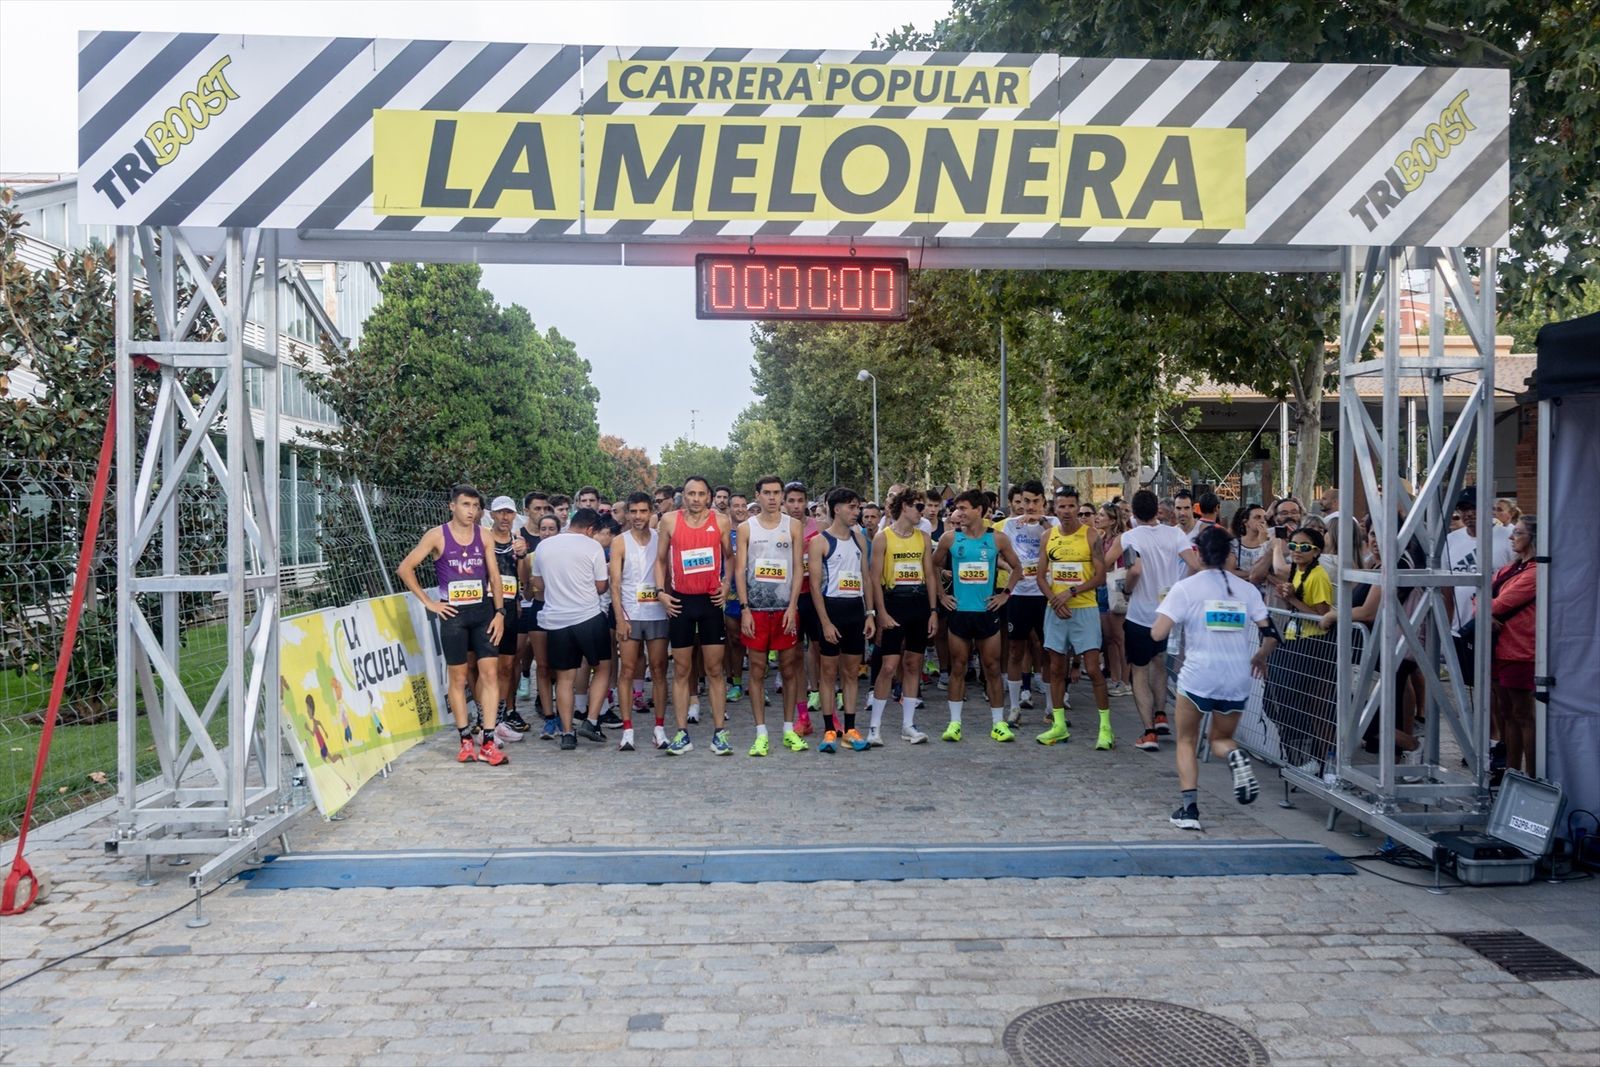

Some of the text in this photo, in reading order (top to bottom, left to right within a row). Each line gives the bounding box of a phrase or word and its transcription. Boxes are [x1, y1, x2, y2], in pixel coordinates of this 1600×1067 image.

[618, 64, 1020, 105] CARRERA POPULAR
[92, 54, 241, 210] TRIBOOST
[420, 119, 1204, 221] LA MELONERA
[1349, 88, 1480, 233] TRIBOOST
[711, 264, 895, 312] 00:00:00
[687, 557, 711, 567] 1185
[760, 567, 783, 576] 2738
[963, 570, 985, 578] 3325
[454, 589, 479, 598] 3790
[641, 591, 658, 599] 349
[342, 616, 362, 650] LA
[1211, 613, 1241, 622] 1274
[353, 643, 408, 692] ESCUELA
